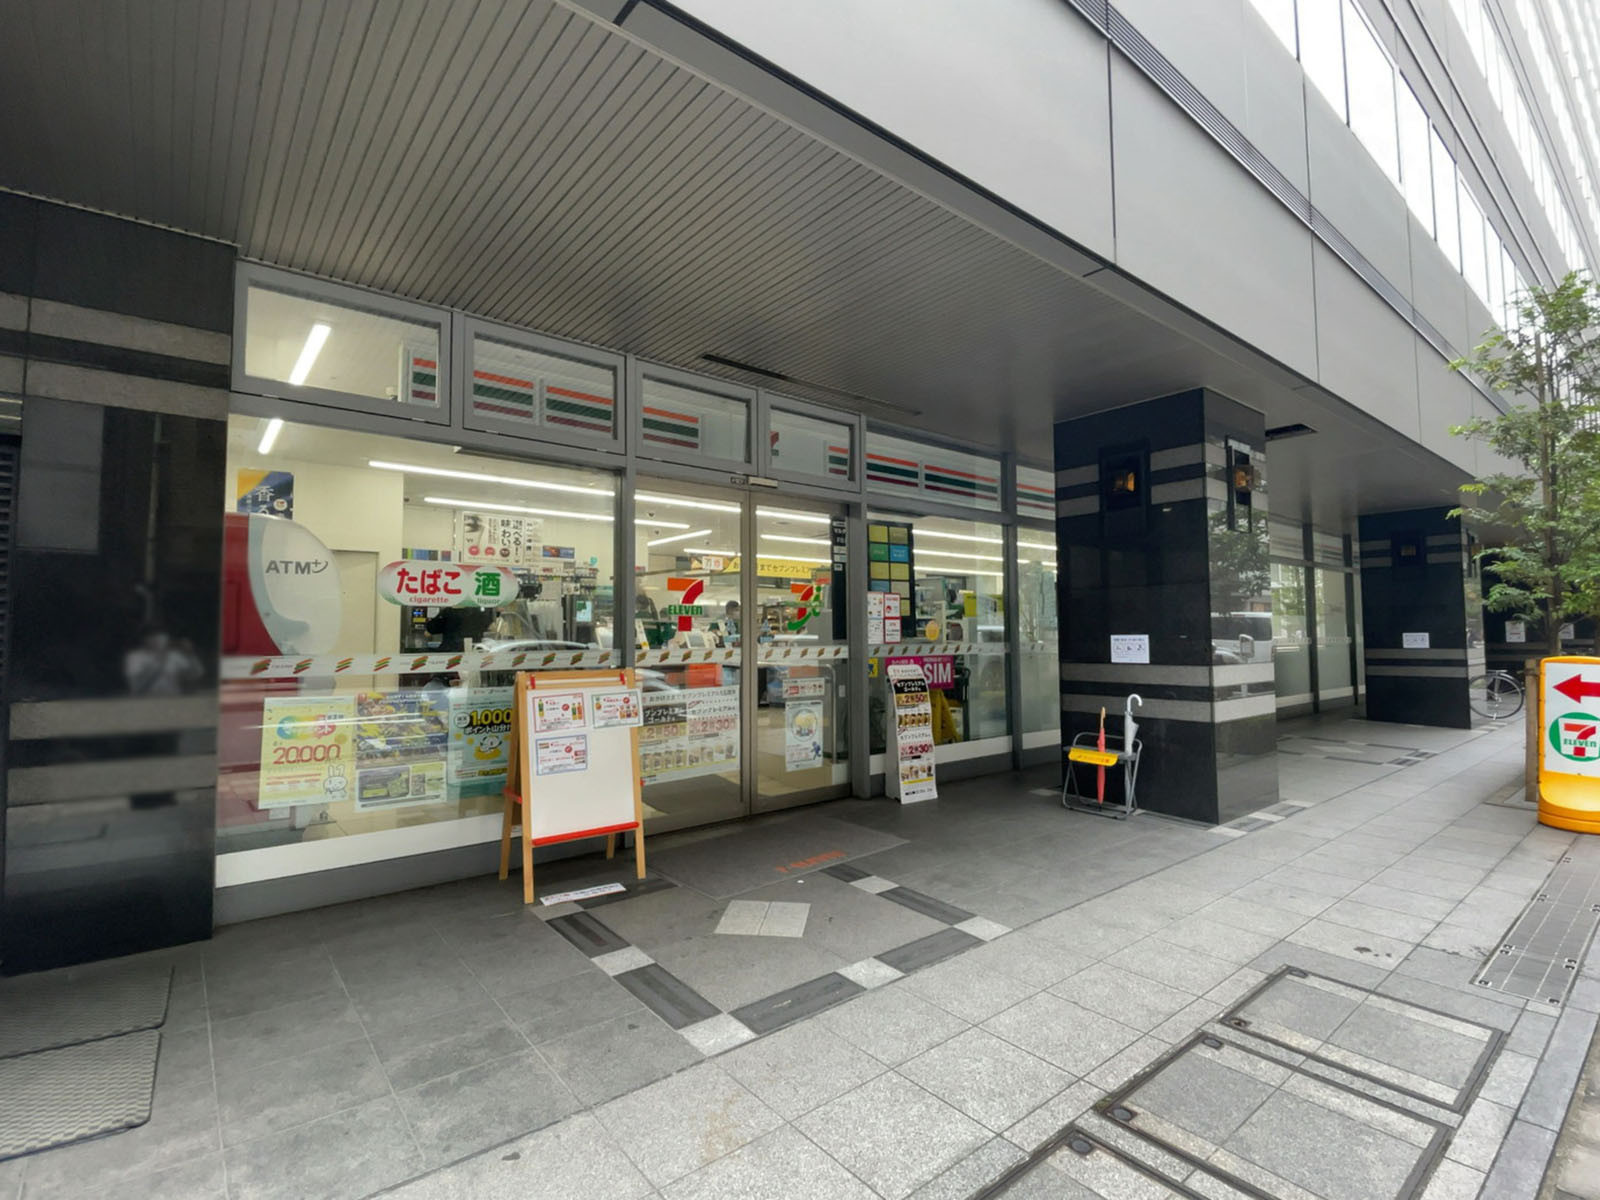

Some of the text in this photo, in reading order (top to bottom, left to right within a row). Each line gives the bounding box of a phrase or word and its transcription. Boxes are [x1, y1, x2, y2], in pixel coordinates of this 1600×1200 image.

[265, 559, 312, 575] ATM
[396, 567, 501, 597] たばこ 酒
[409, 595, 449, 606] cigarette
[924, 663, 952, 684] SIM
[1564, 722, 1597, 757] 7
